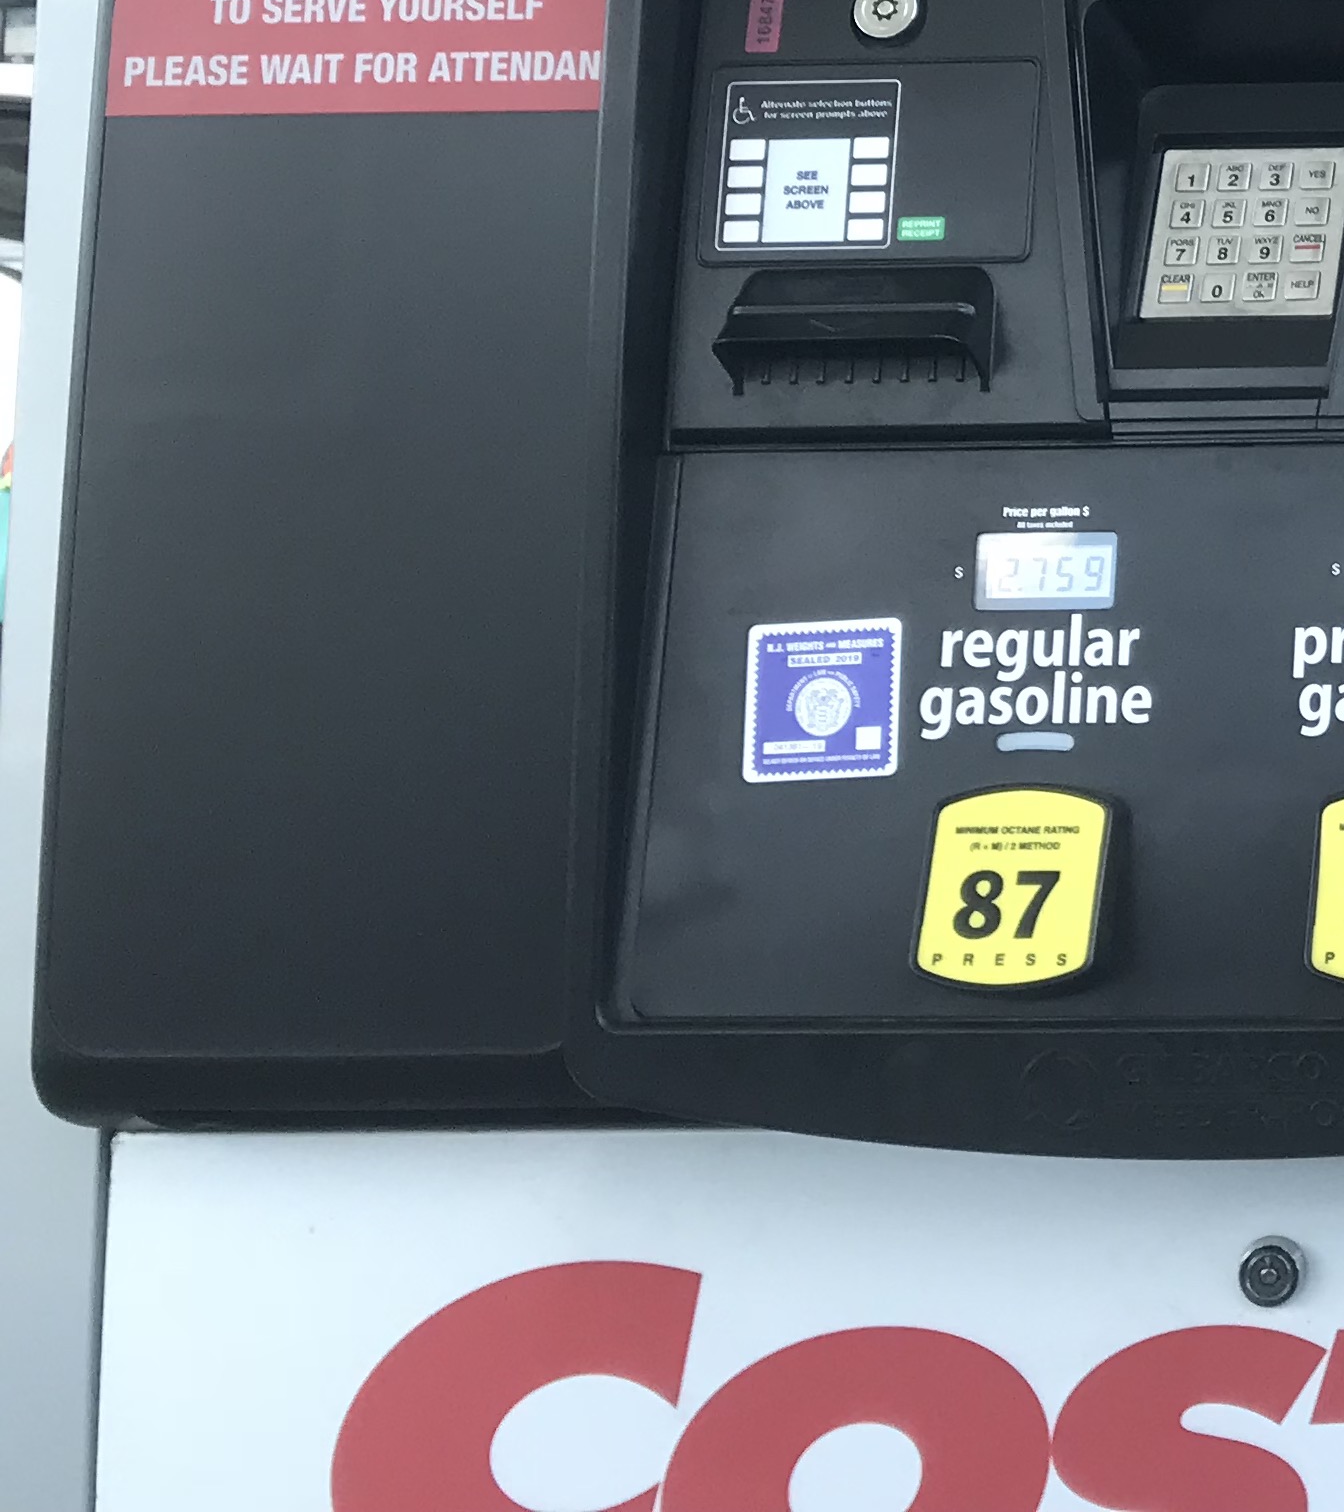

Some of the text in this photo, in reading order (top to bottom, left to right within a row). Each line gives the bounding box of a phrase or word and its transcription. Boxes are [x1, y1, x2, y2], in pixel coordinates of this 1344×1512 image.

[124, 55, 249, 87] PLEASE
[261, 53, 344, 84] WAIT
[354, 52, 417, 84] FOR
[797, 171, 818, 181] SEE
[1309, 170, 1326, 178] YES
[784, 185, 828, 196] SCREEN
[786, 199, 824, 210] ABOVE
[1293, 234, 1325, 243] CANCEL
[1162, 274, 1190, 284] CLEAR
[941, 614, 1140, 683] regular
[920, 671, 1152, 742] gasoline
[953, 870, 1061, 939] 87
